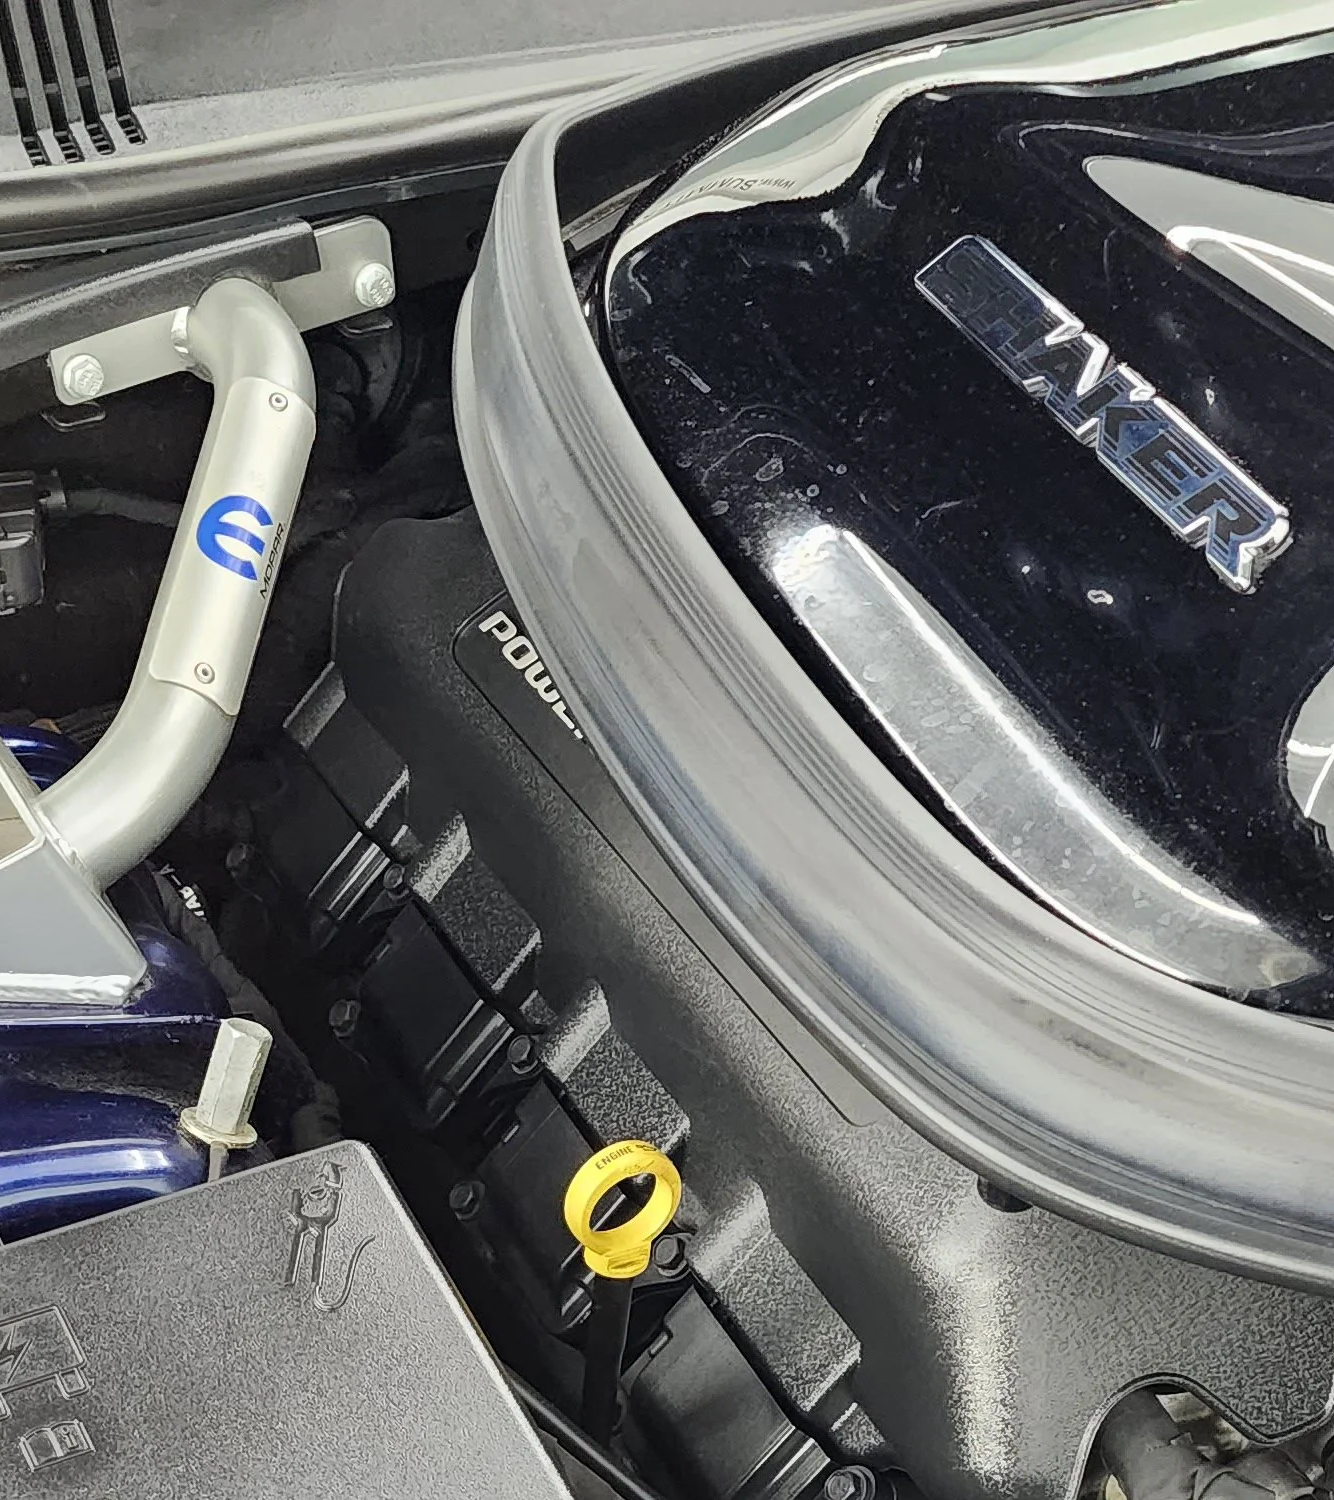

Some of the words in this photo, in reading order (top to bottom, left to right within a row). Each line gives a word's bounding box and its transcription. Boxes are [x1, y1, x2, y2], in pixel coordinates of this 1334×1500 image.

[915, 236, 1291, 592] SHAKER
[260, 522, 284, 599] MOPAR
[478, 611, 584, 740] POW
[595, 1145, 635, 1171] ENGINE
